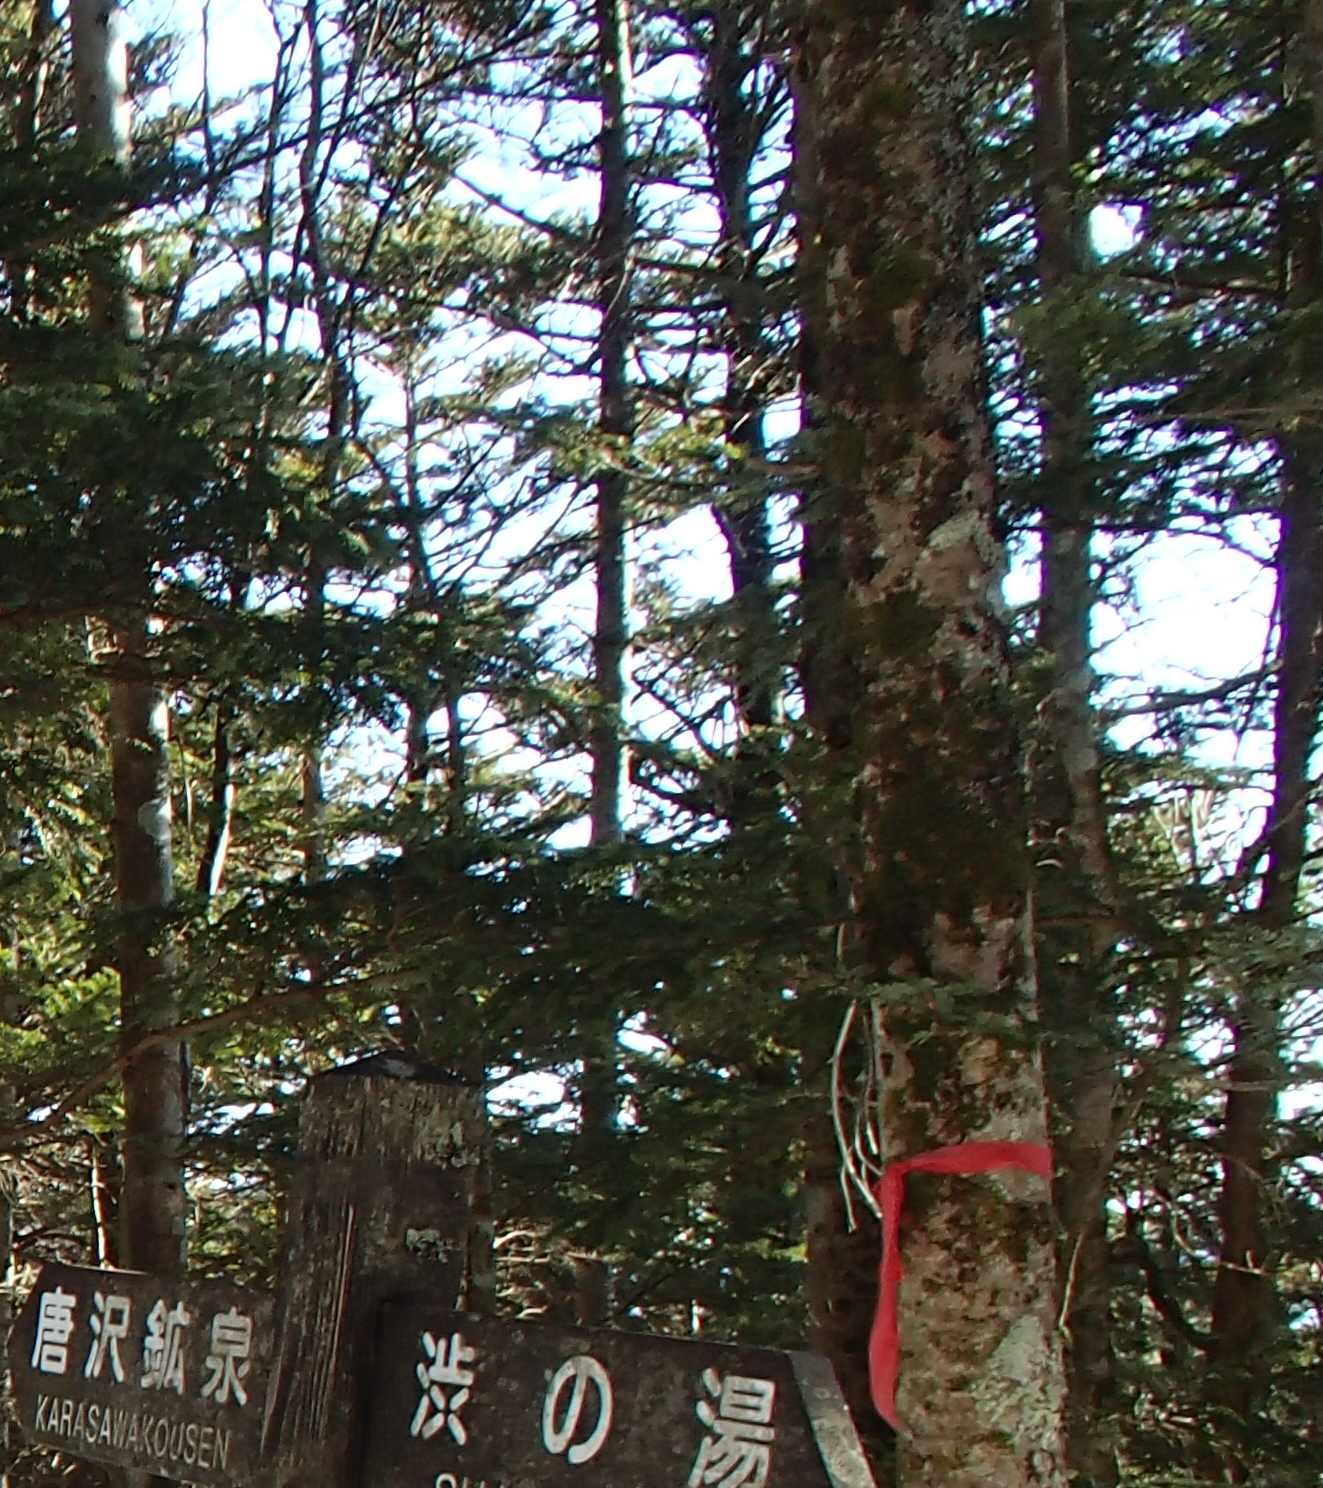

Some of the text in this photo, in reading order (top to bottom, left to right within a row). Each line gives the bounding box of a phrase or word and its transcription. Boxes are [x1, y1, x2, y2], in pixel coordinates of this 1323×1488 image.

[31, 1286, 254, 1407] 唐沢鉱泉
[35, 1394, 232, 1470] KARASAWAKOUSEN
